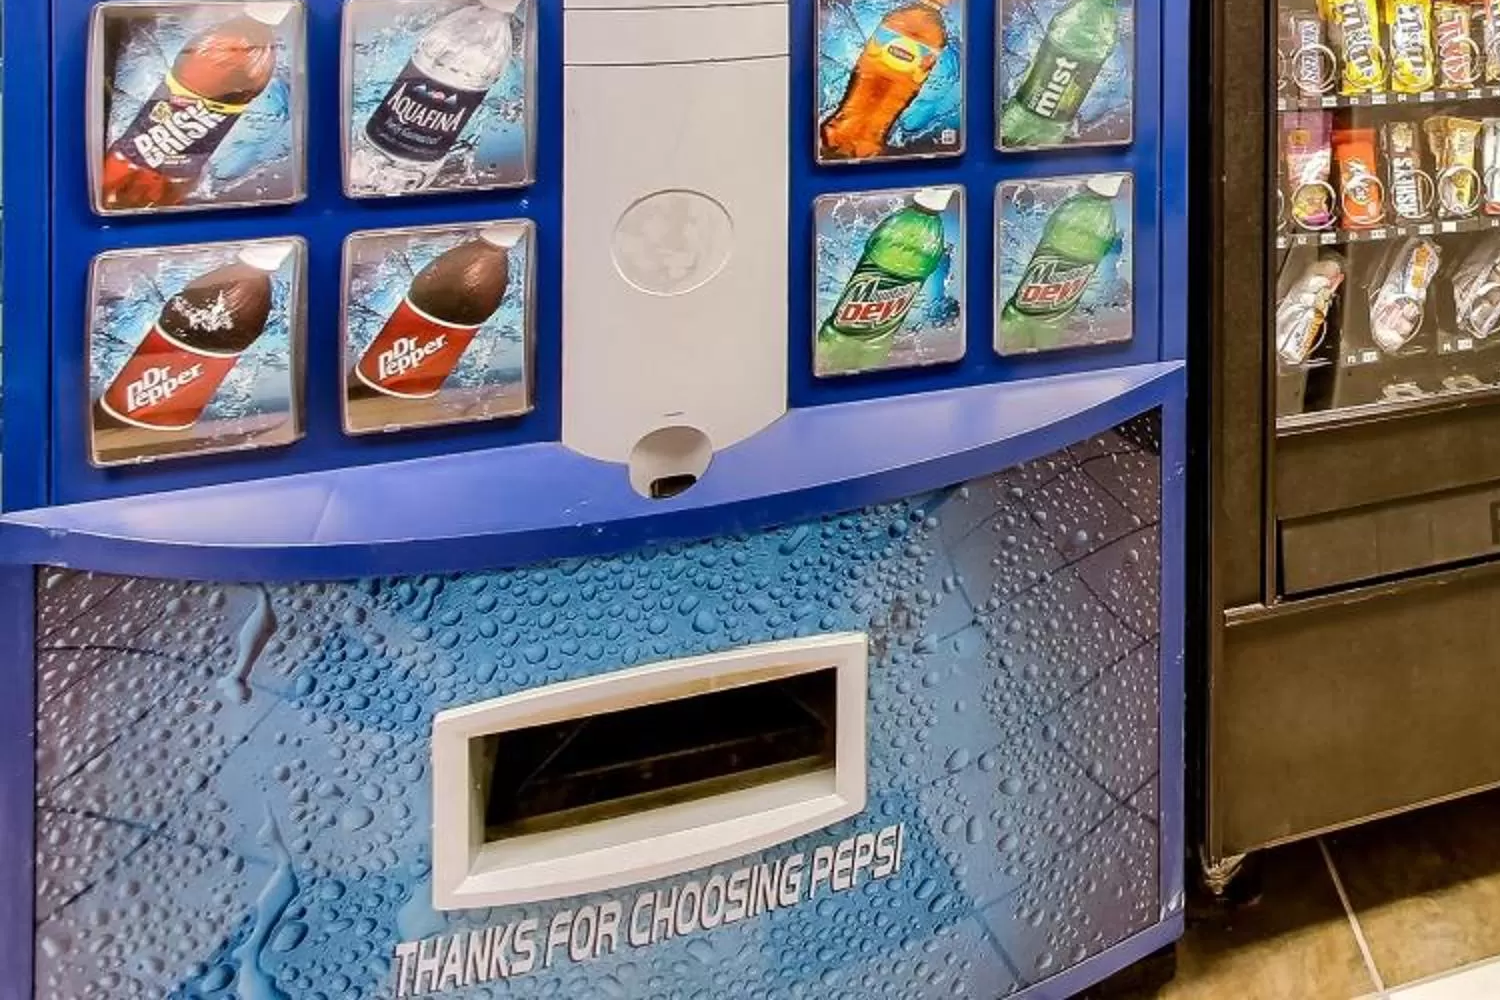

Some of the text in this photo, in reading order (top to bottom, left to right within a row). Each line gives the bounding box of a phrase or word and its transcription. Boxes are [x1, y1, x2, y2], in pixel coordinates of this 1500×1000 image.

[387, 82, 467, 132] AQUAFINA
[133, 101, 227, 168] BRISK
[378, 333, 447, 380] Pepper
[392, 335, 419, 358] Dr
[127, 363, 202, 412] Pepper
[143, 366, 172, 388] Dr
[393, 821, 905, 998] THANKS FOR CHOOSING PEPSI
